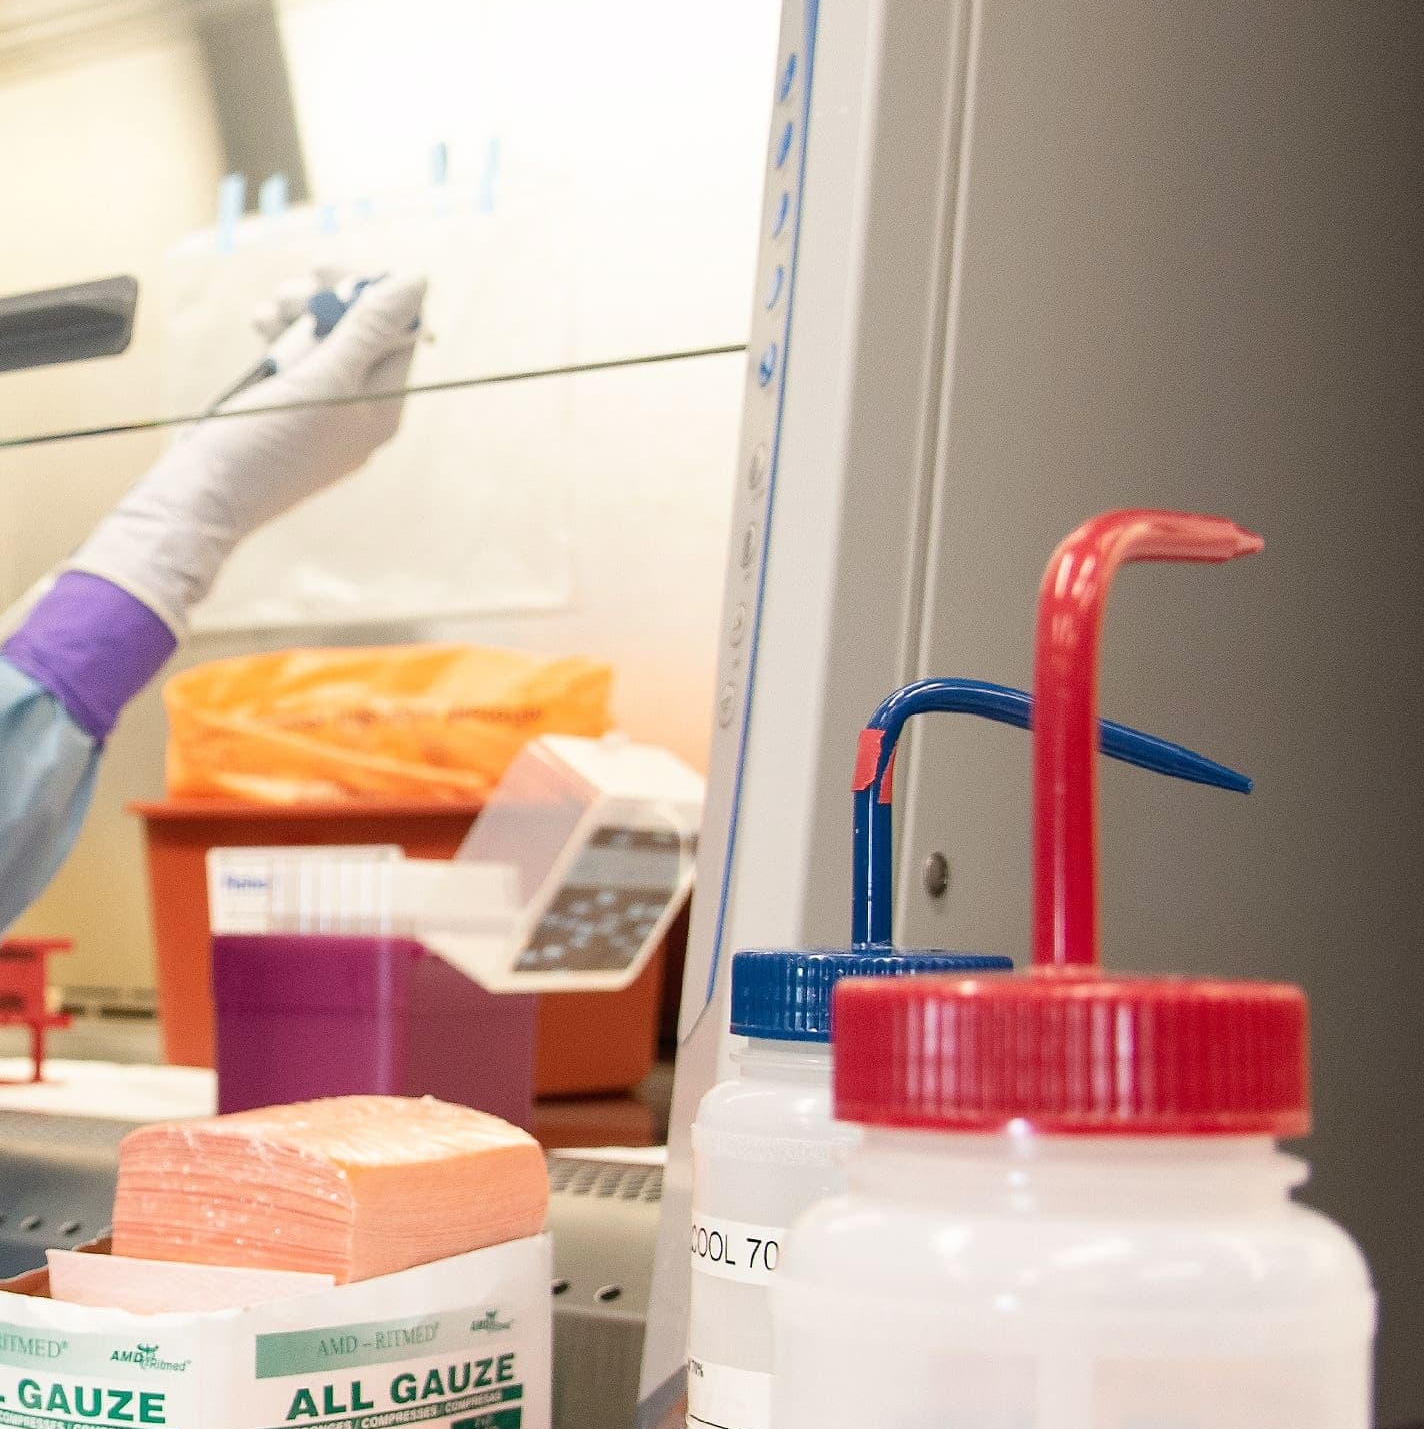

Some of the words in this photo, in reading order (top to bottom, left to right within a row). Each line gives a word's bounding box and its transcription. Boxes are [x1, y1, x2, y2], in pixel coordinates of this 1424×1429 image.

[111, 1350, 144, 1363] AMD
[318, 1335, 358, 1358] AMD
[286, 1381, 374, 1420] ALL
[390, 1352, 515, 1404] GAUZE
[18, 1378, 166, 1424] GAUZE
[361, 1404, 438, 1428] COMPRESSES
